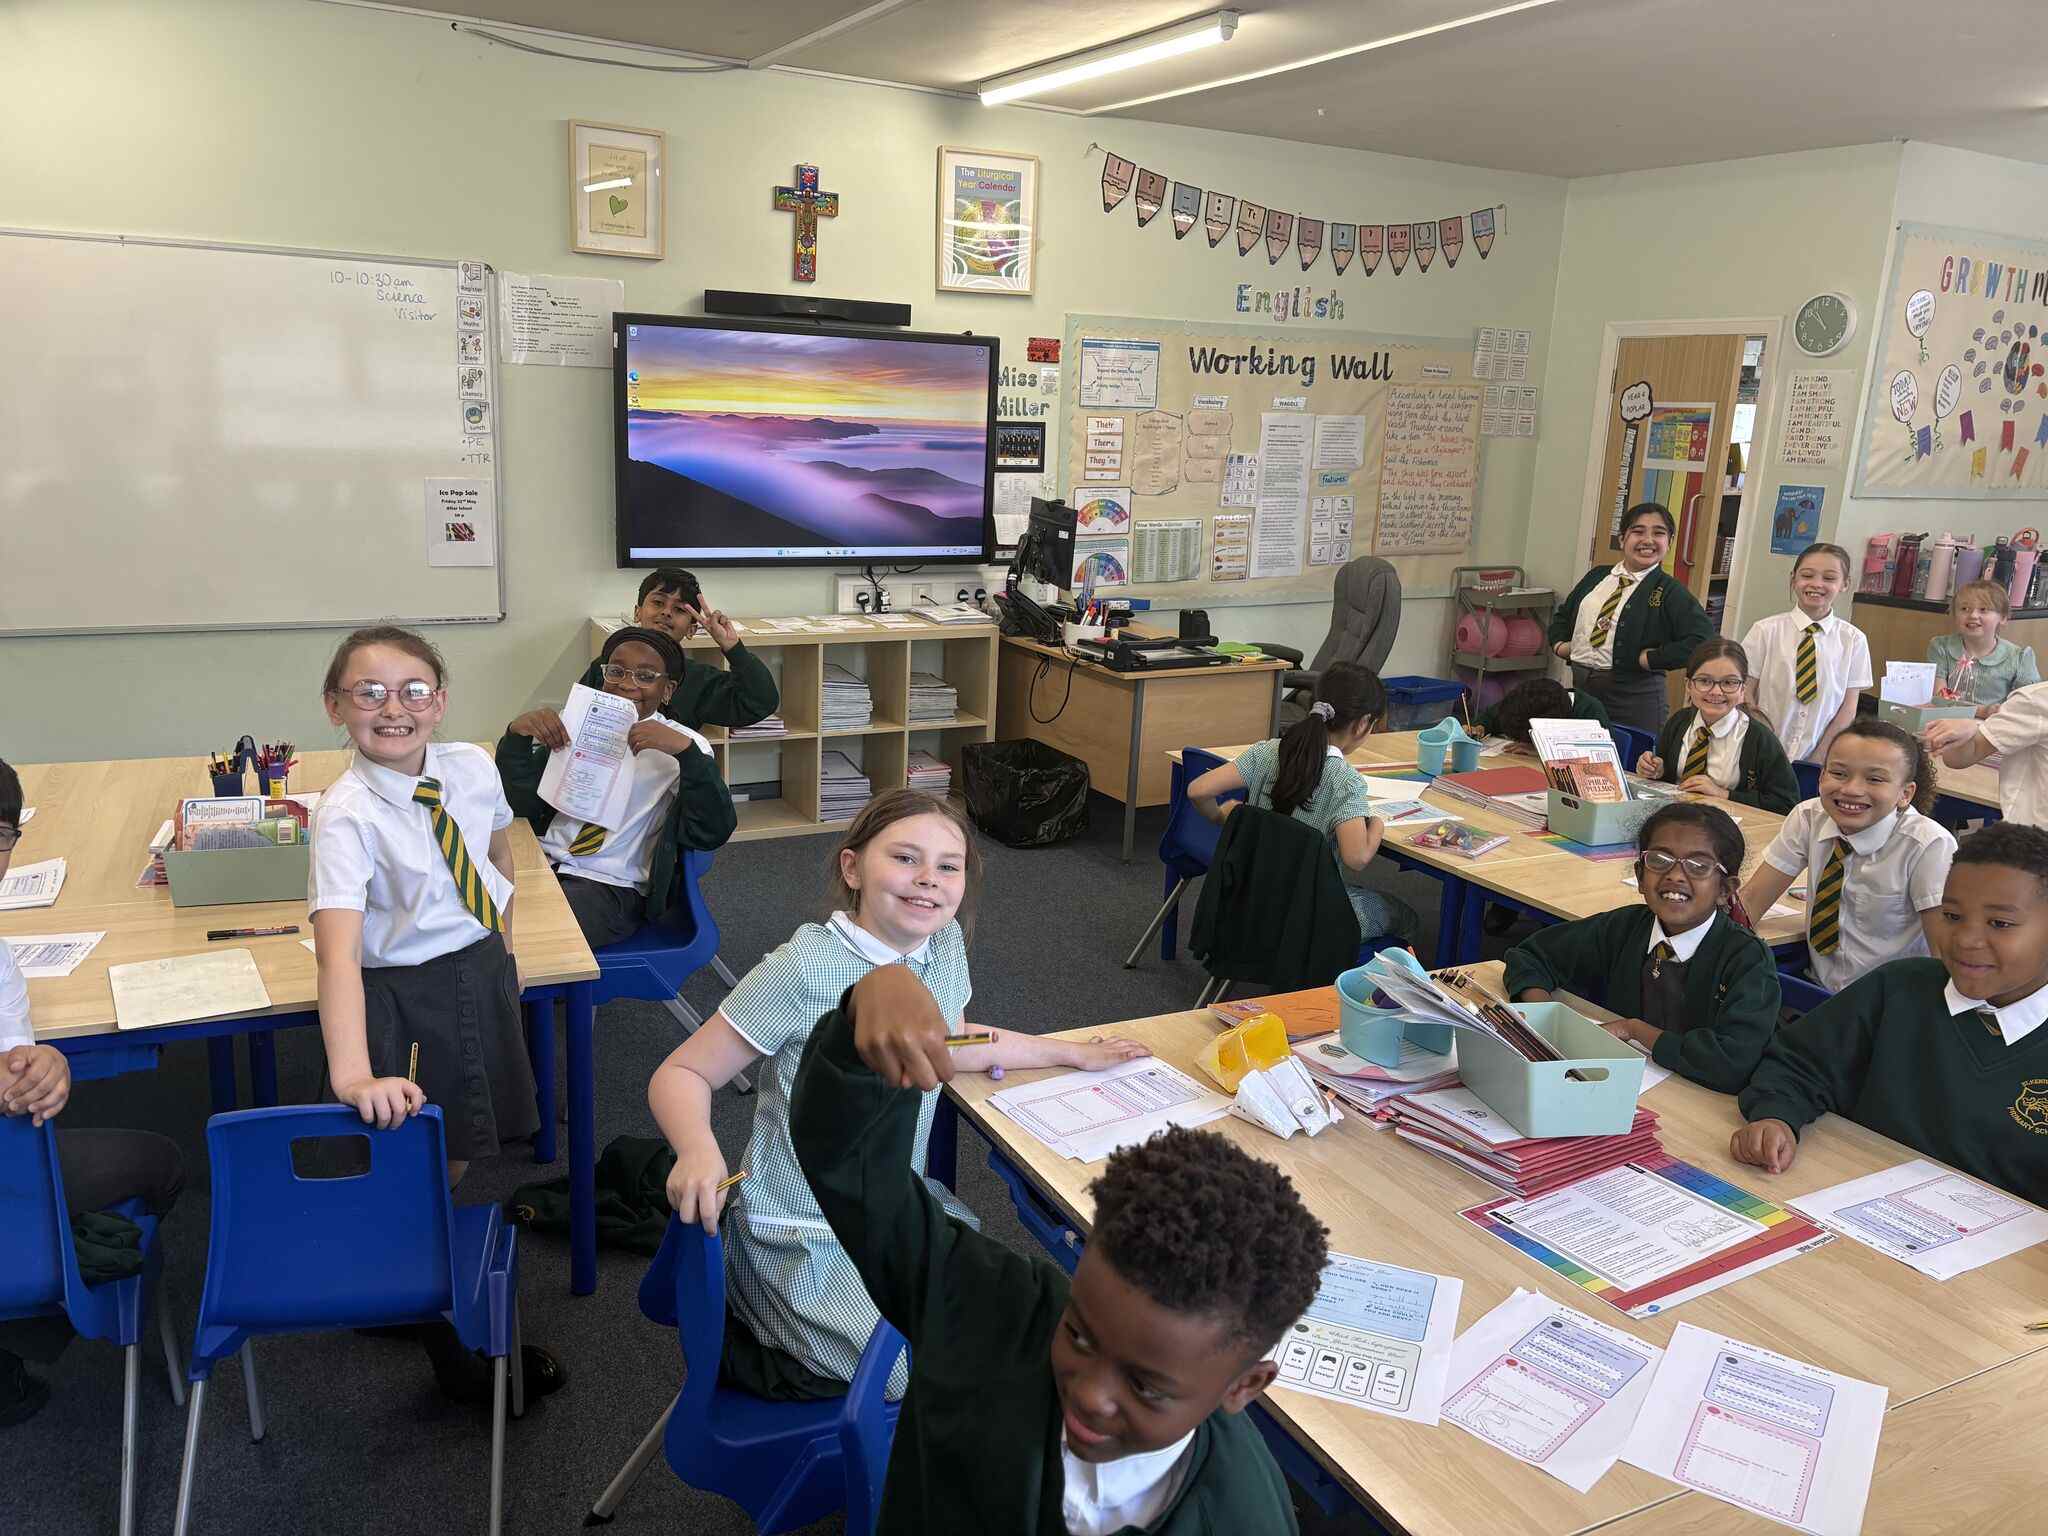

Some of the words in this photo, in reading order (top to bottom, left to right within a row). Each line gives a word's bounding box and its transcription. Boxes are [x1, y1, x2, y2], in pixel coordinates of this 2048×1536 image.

[961, 168, 975, 177] The
[978, 181, 1016, 192] Calendar
[1941, 256, 2028, 303] GROWTH
[376, 290, 427, 304] Science
[1235, 283, 1345, 322] English
[1822, 297, 1831, 306] 12
[394, 308, 437, 321] Visitor
[1189, 345, 1316, 387] Working
[1330, 351, 1394, 381] Wall
[1096, 421, 1114, 429] Their
[1093, 439, 1115, 447] There
[467, 453, 491, 464] TTR
